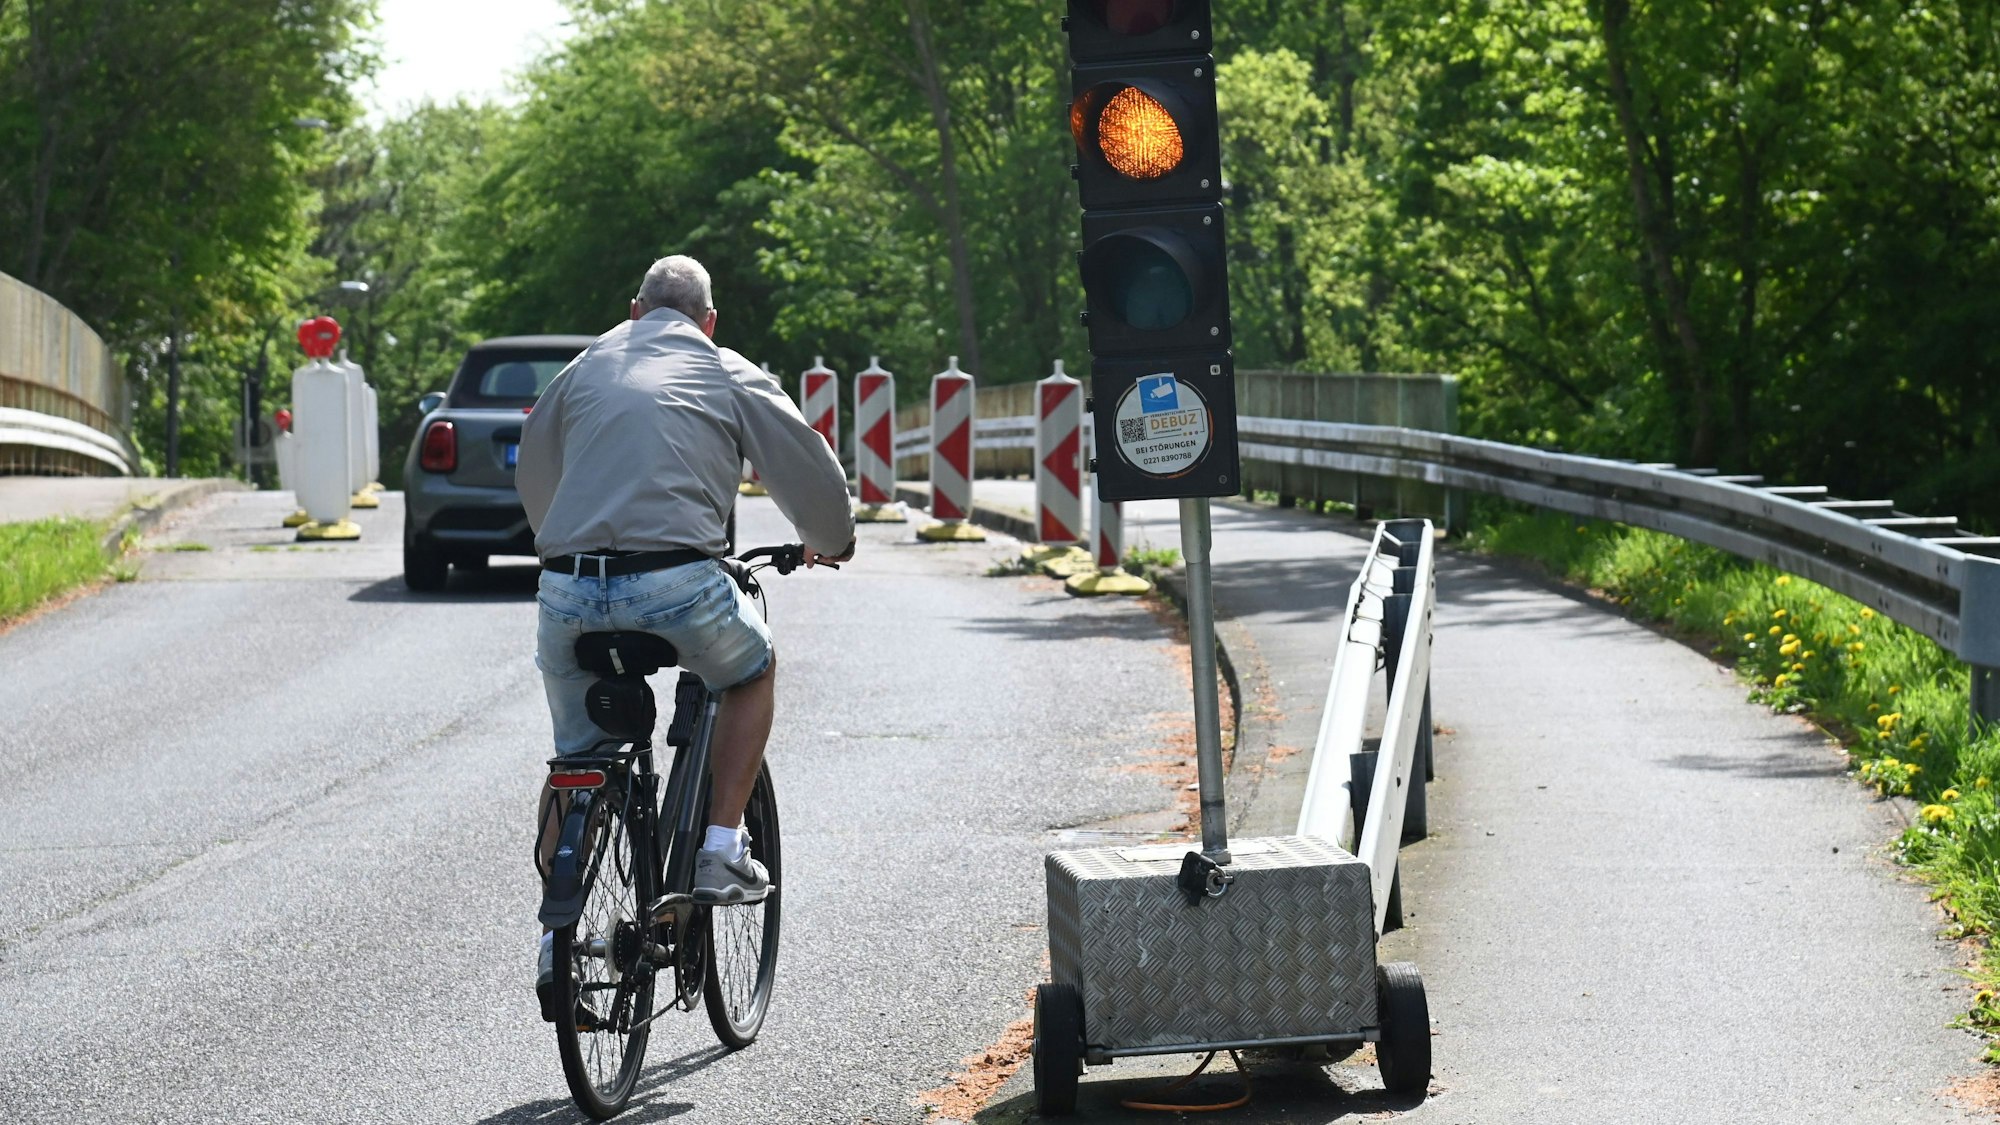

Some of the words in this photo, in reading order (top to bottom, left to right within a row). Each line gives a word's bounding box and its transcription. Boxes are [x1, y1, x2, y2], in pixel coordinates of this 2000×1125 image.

[1150, 413, 1197, 430] DEBUZ
[1149, 440, 1196, 452] STÖRUNGEN
[1143, 456, 1160, 465] 0221
[1161, 452, 1192, 462] 8390788
